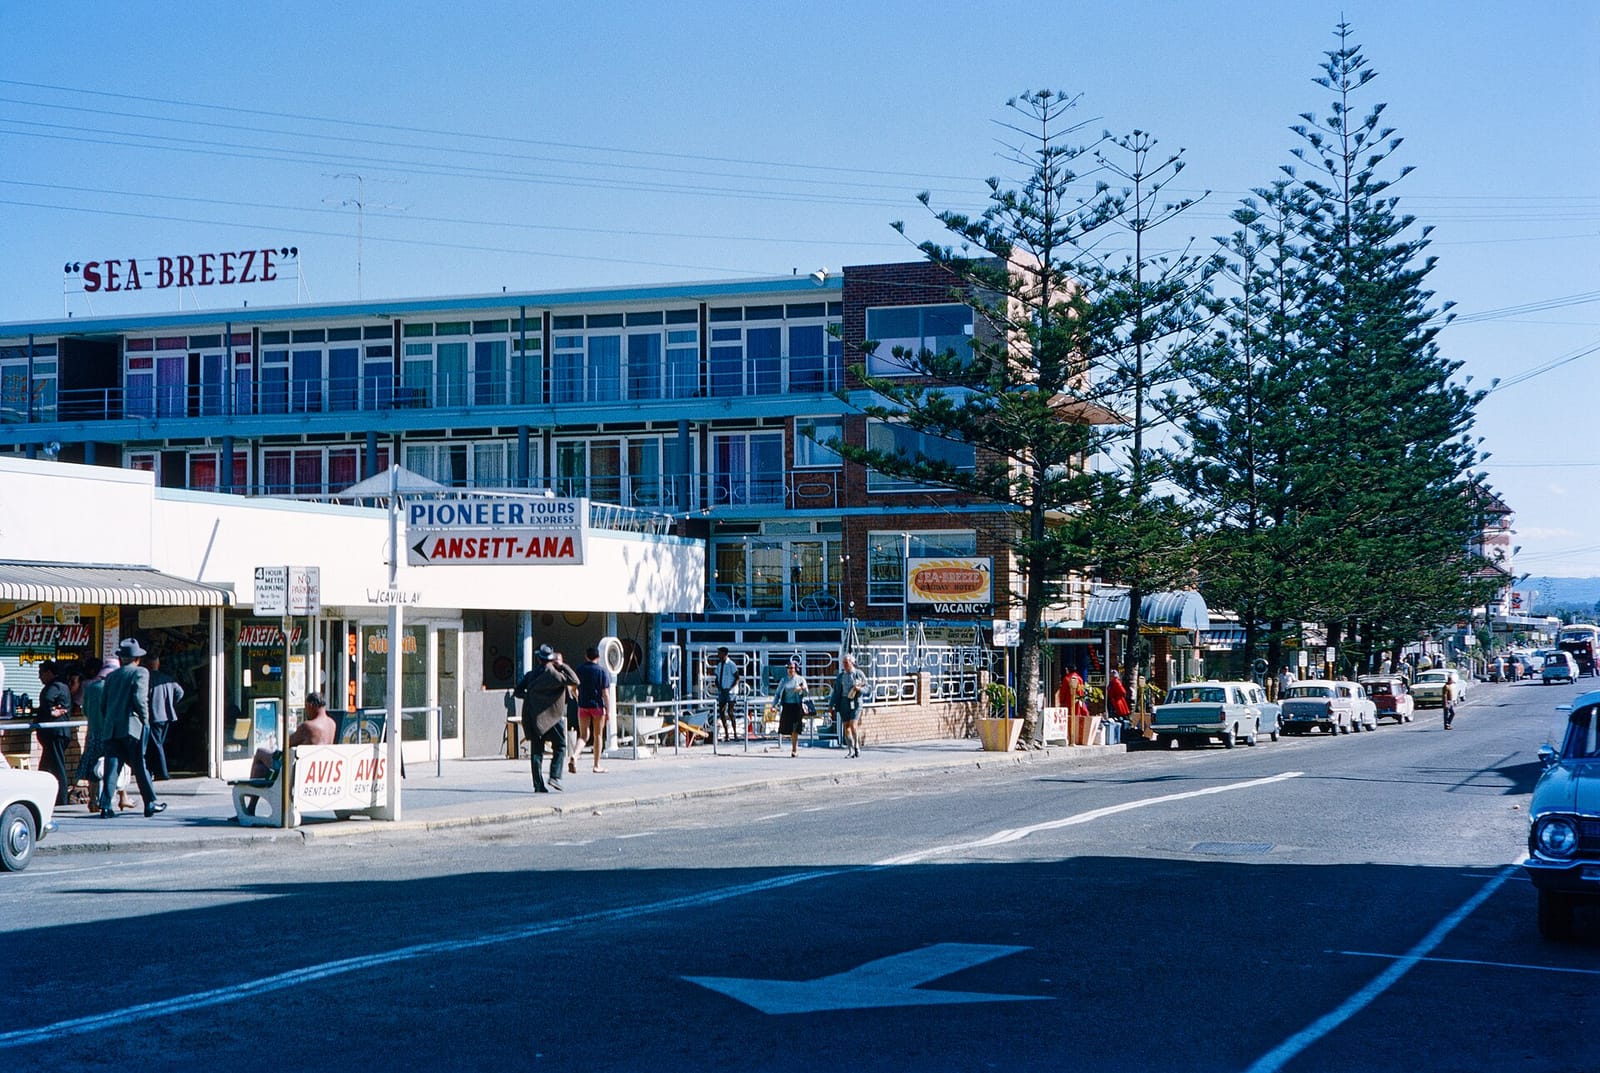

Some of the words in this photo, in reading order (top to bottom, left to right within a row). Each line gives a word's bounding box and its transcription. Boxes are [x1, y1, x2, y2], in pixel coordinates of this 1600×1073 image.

[410, 503, 524, 525] PIONEER
[529, 502, 575, 514] TOURS
[530, 515, 574, 524] EXPRESS
[431, 537, 575, 559] ANSETT-ANA
[255, 568, 264, 580] 4
[297, 575, 311, 584] NO
[380, 591, 407, 604] CAVILL
[933, 603, 988, 614] VACANCY
[305, 760, 343, 783] AVIS
[355, 758, 385, 781] AVIS
